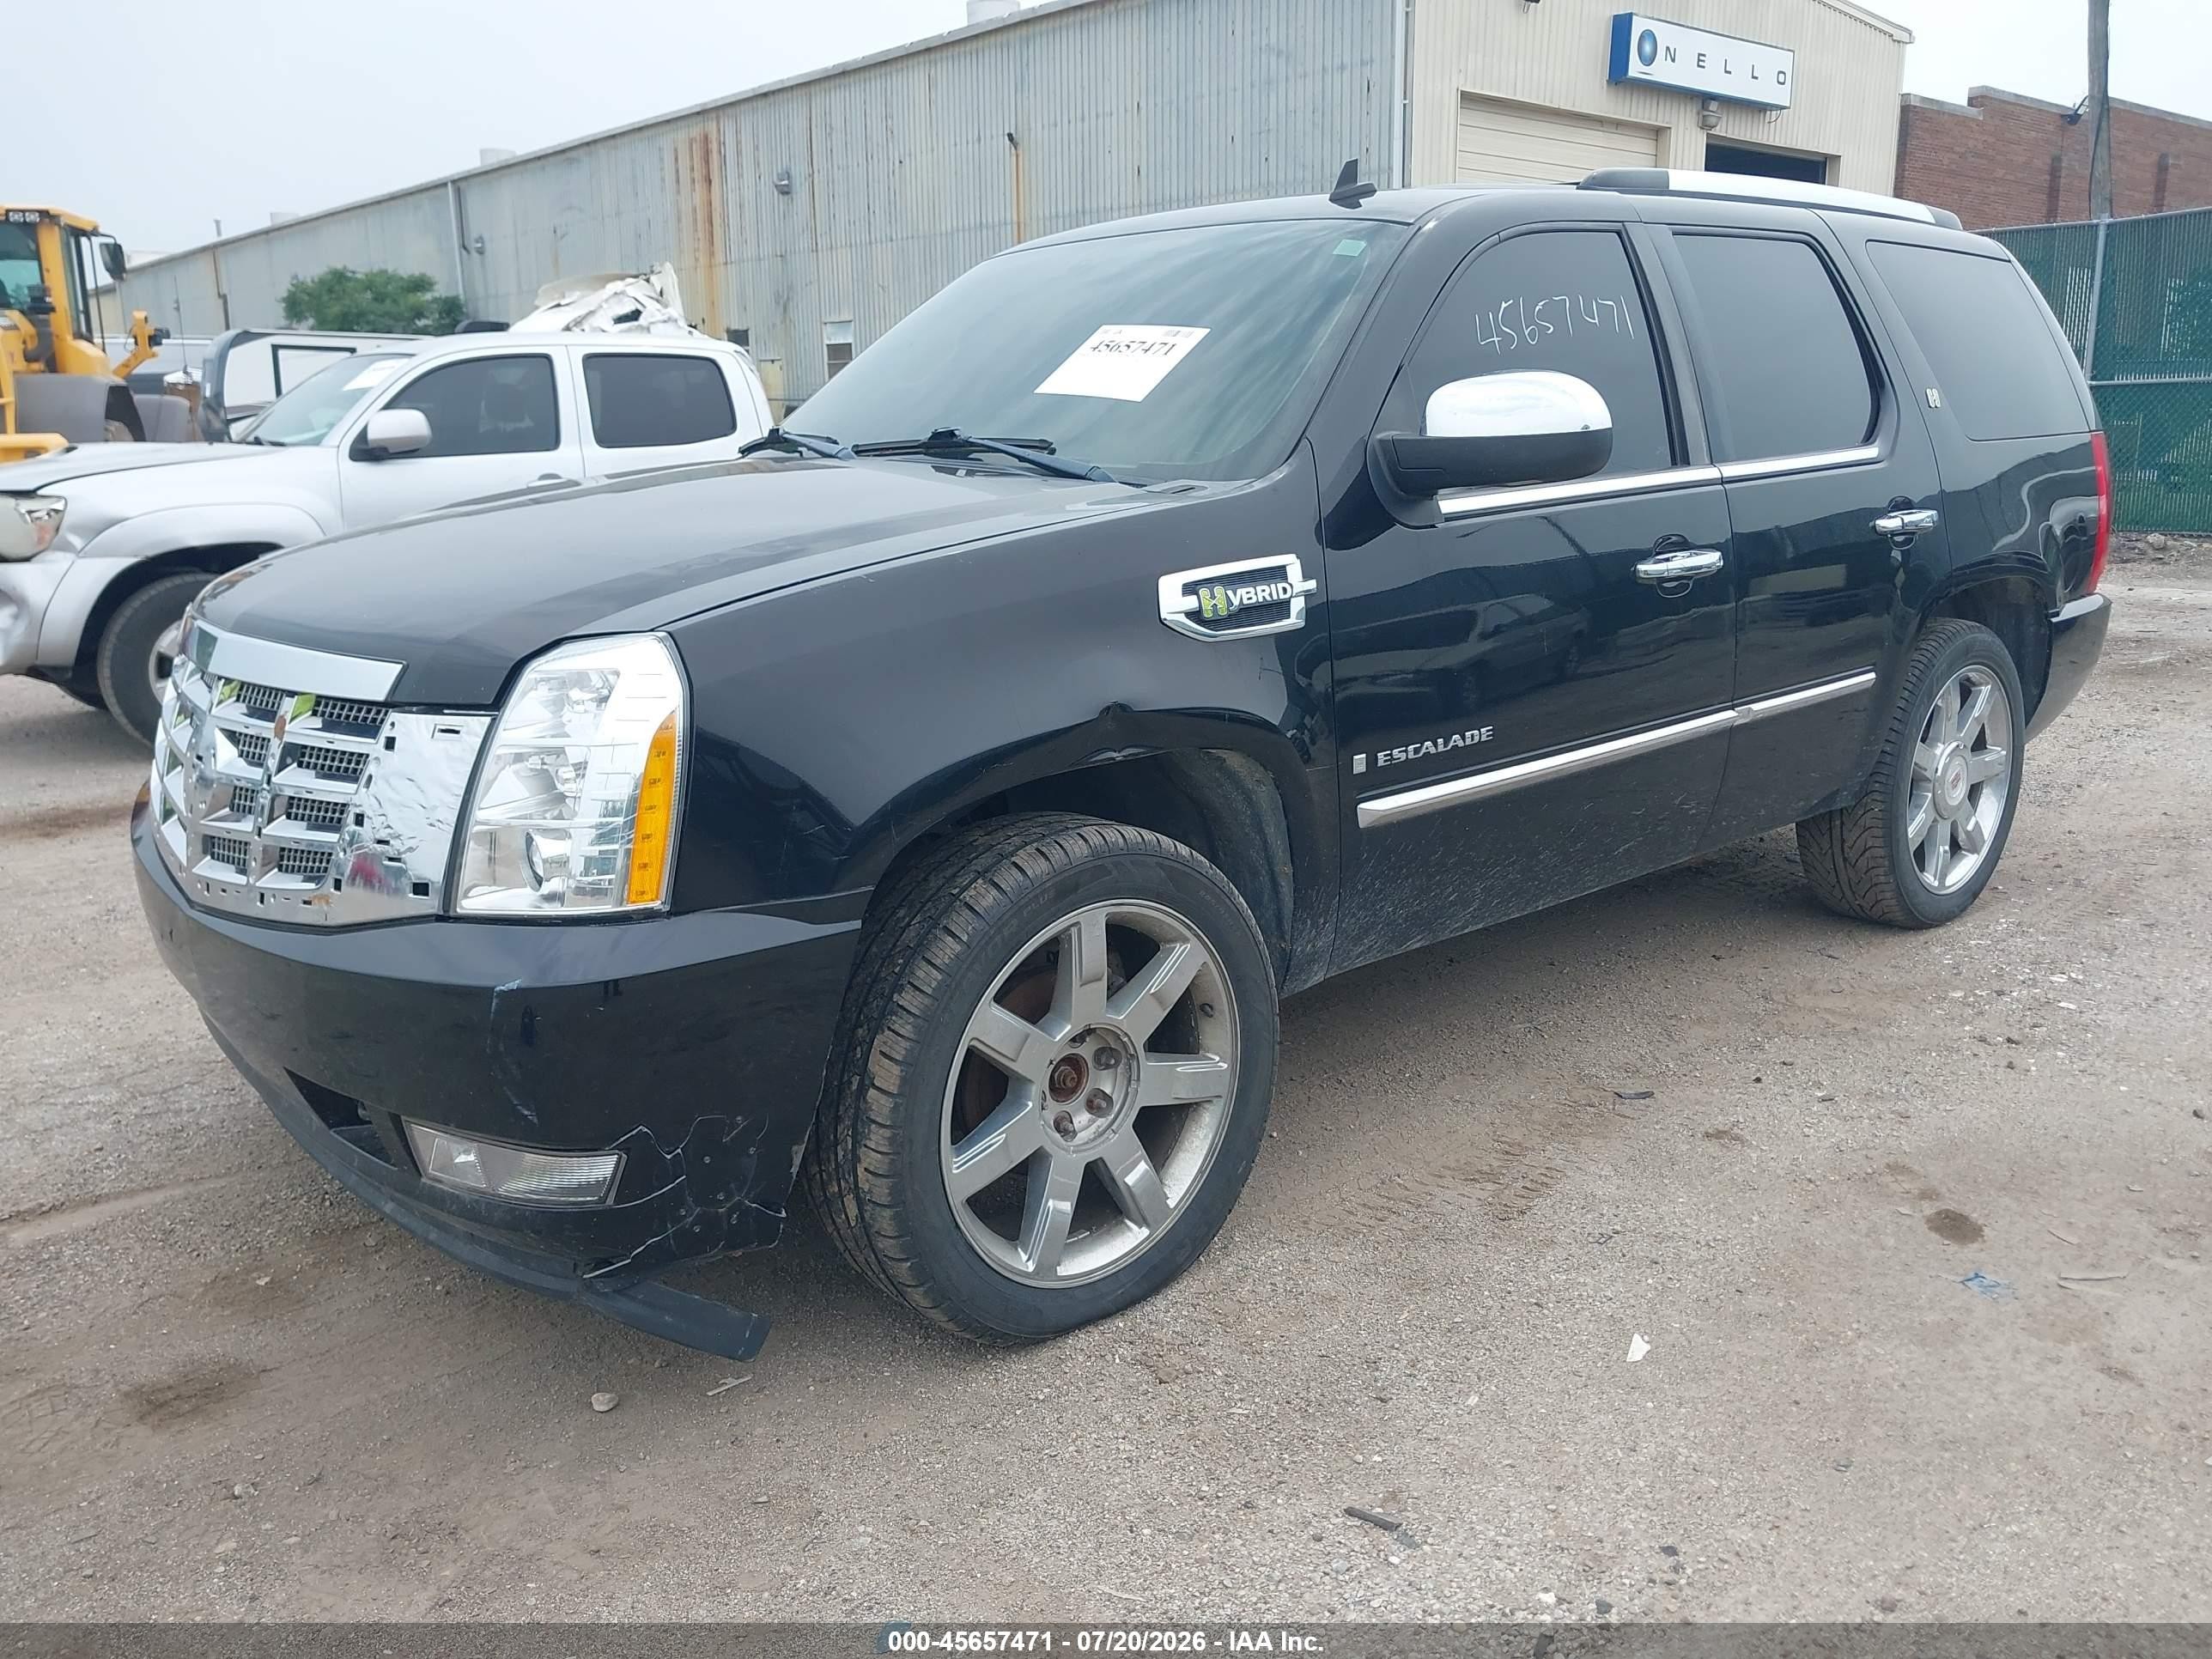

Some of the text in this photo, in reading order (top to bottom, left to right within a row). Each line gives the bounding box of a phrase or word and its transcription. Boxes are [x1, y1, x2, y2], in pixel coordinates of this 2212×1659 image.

[1475, 295, 1635, 356] 45657471
[1199, 582, 1292, 618] HYBRID
[1376, 726, 1494, 767] ESCALADE
